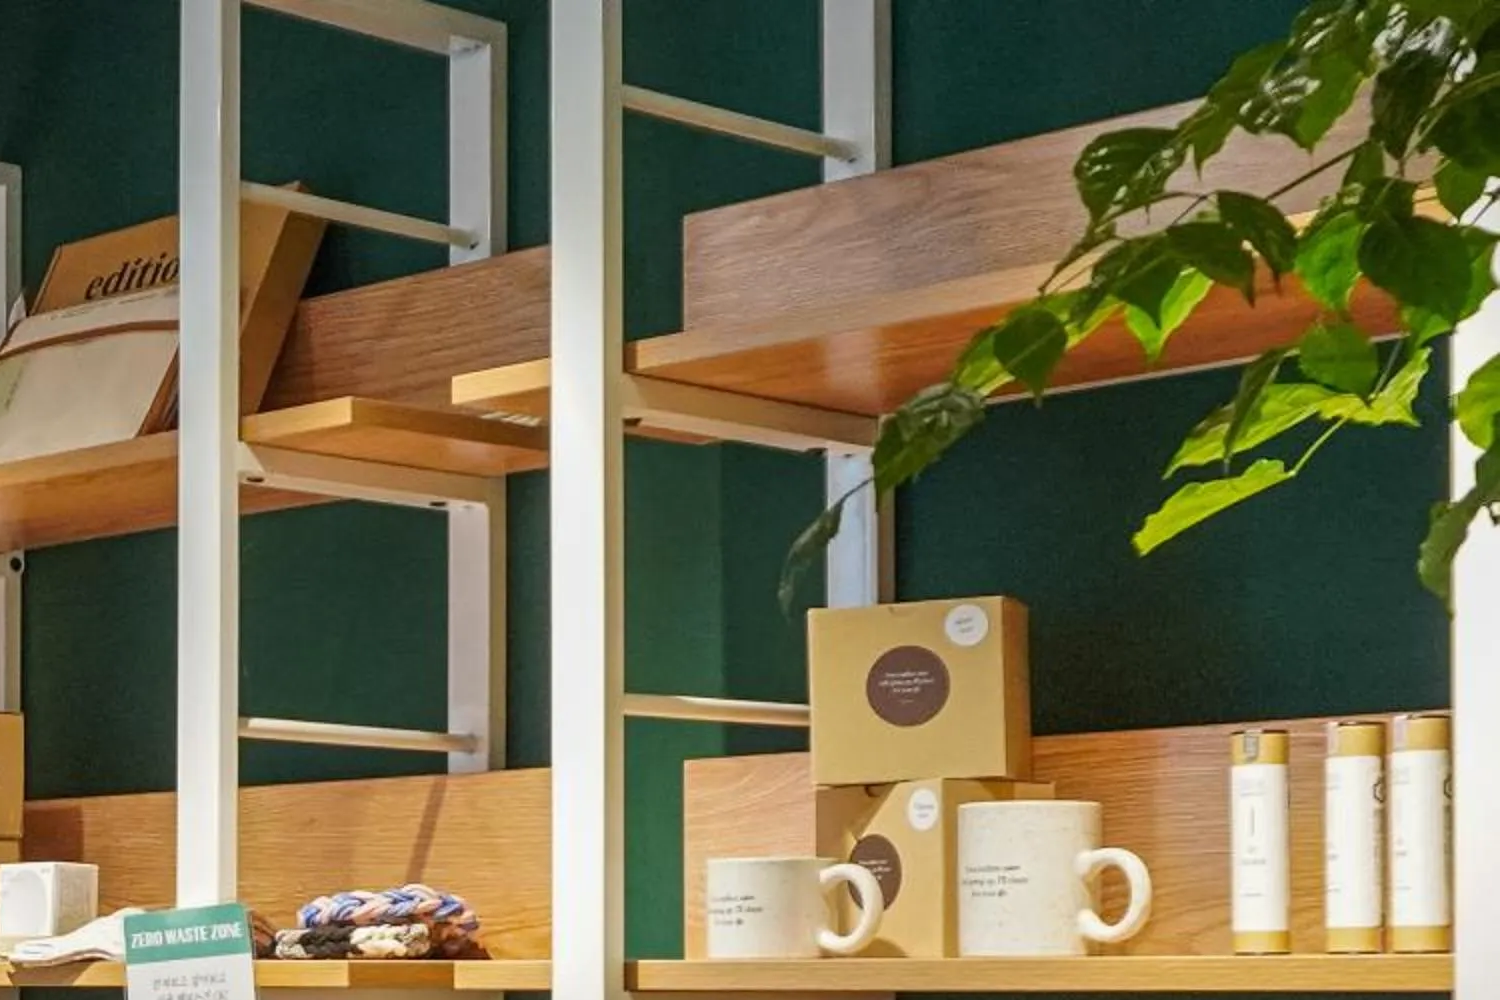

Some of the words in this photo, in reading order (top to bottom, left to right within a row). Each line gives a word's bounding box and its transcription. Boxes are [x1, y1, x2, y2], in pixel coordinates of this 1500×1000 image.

[84, 252, 180, 300] editio
[130, 930, 163, 949] ZERO
[165, 924, 208, 948] WASTE
[211, 921, 244, 941] ZONE
